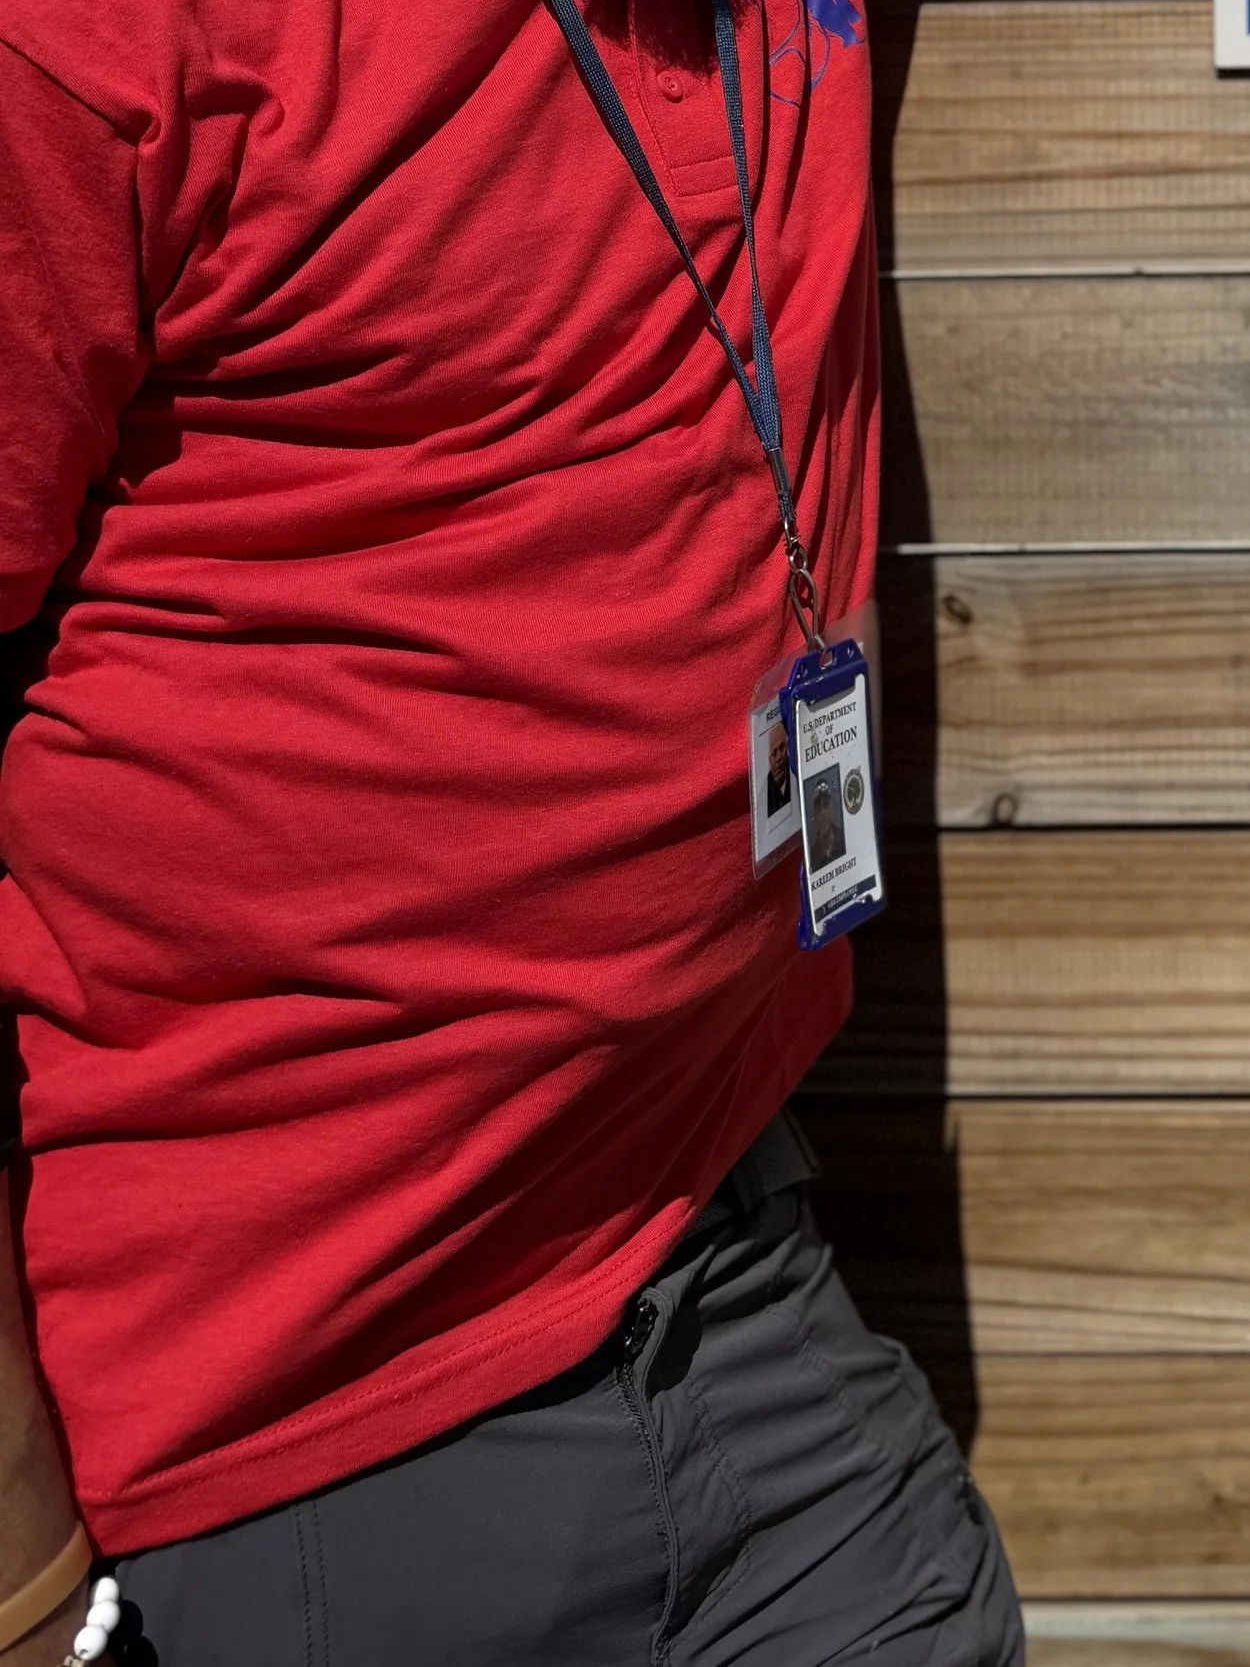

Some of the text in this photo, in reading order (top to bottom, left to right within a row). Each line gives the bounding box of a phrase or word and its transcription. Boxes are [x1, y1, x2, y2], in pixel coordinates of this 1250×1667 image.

[814, 701, 857, 729] DEPARTMENT
[805, 725, 858, 763] EDUCATION
[825, 724, 834, 736] OF
